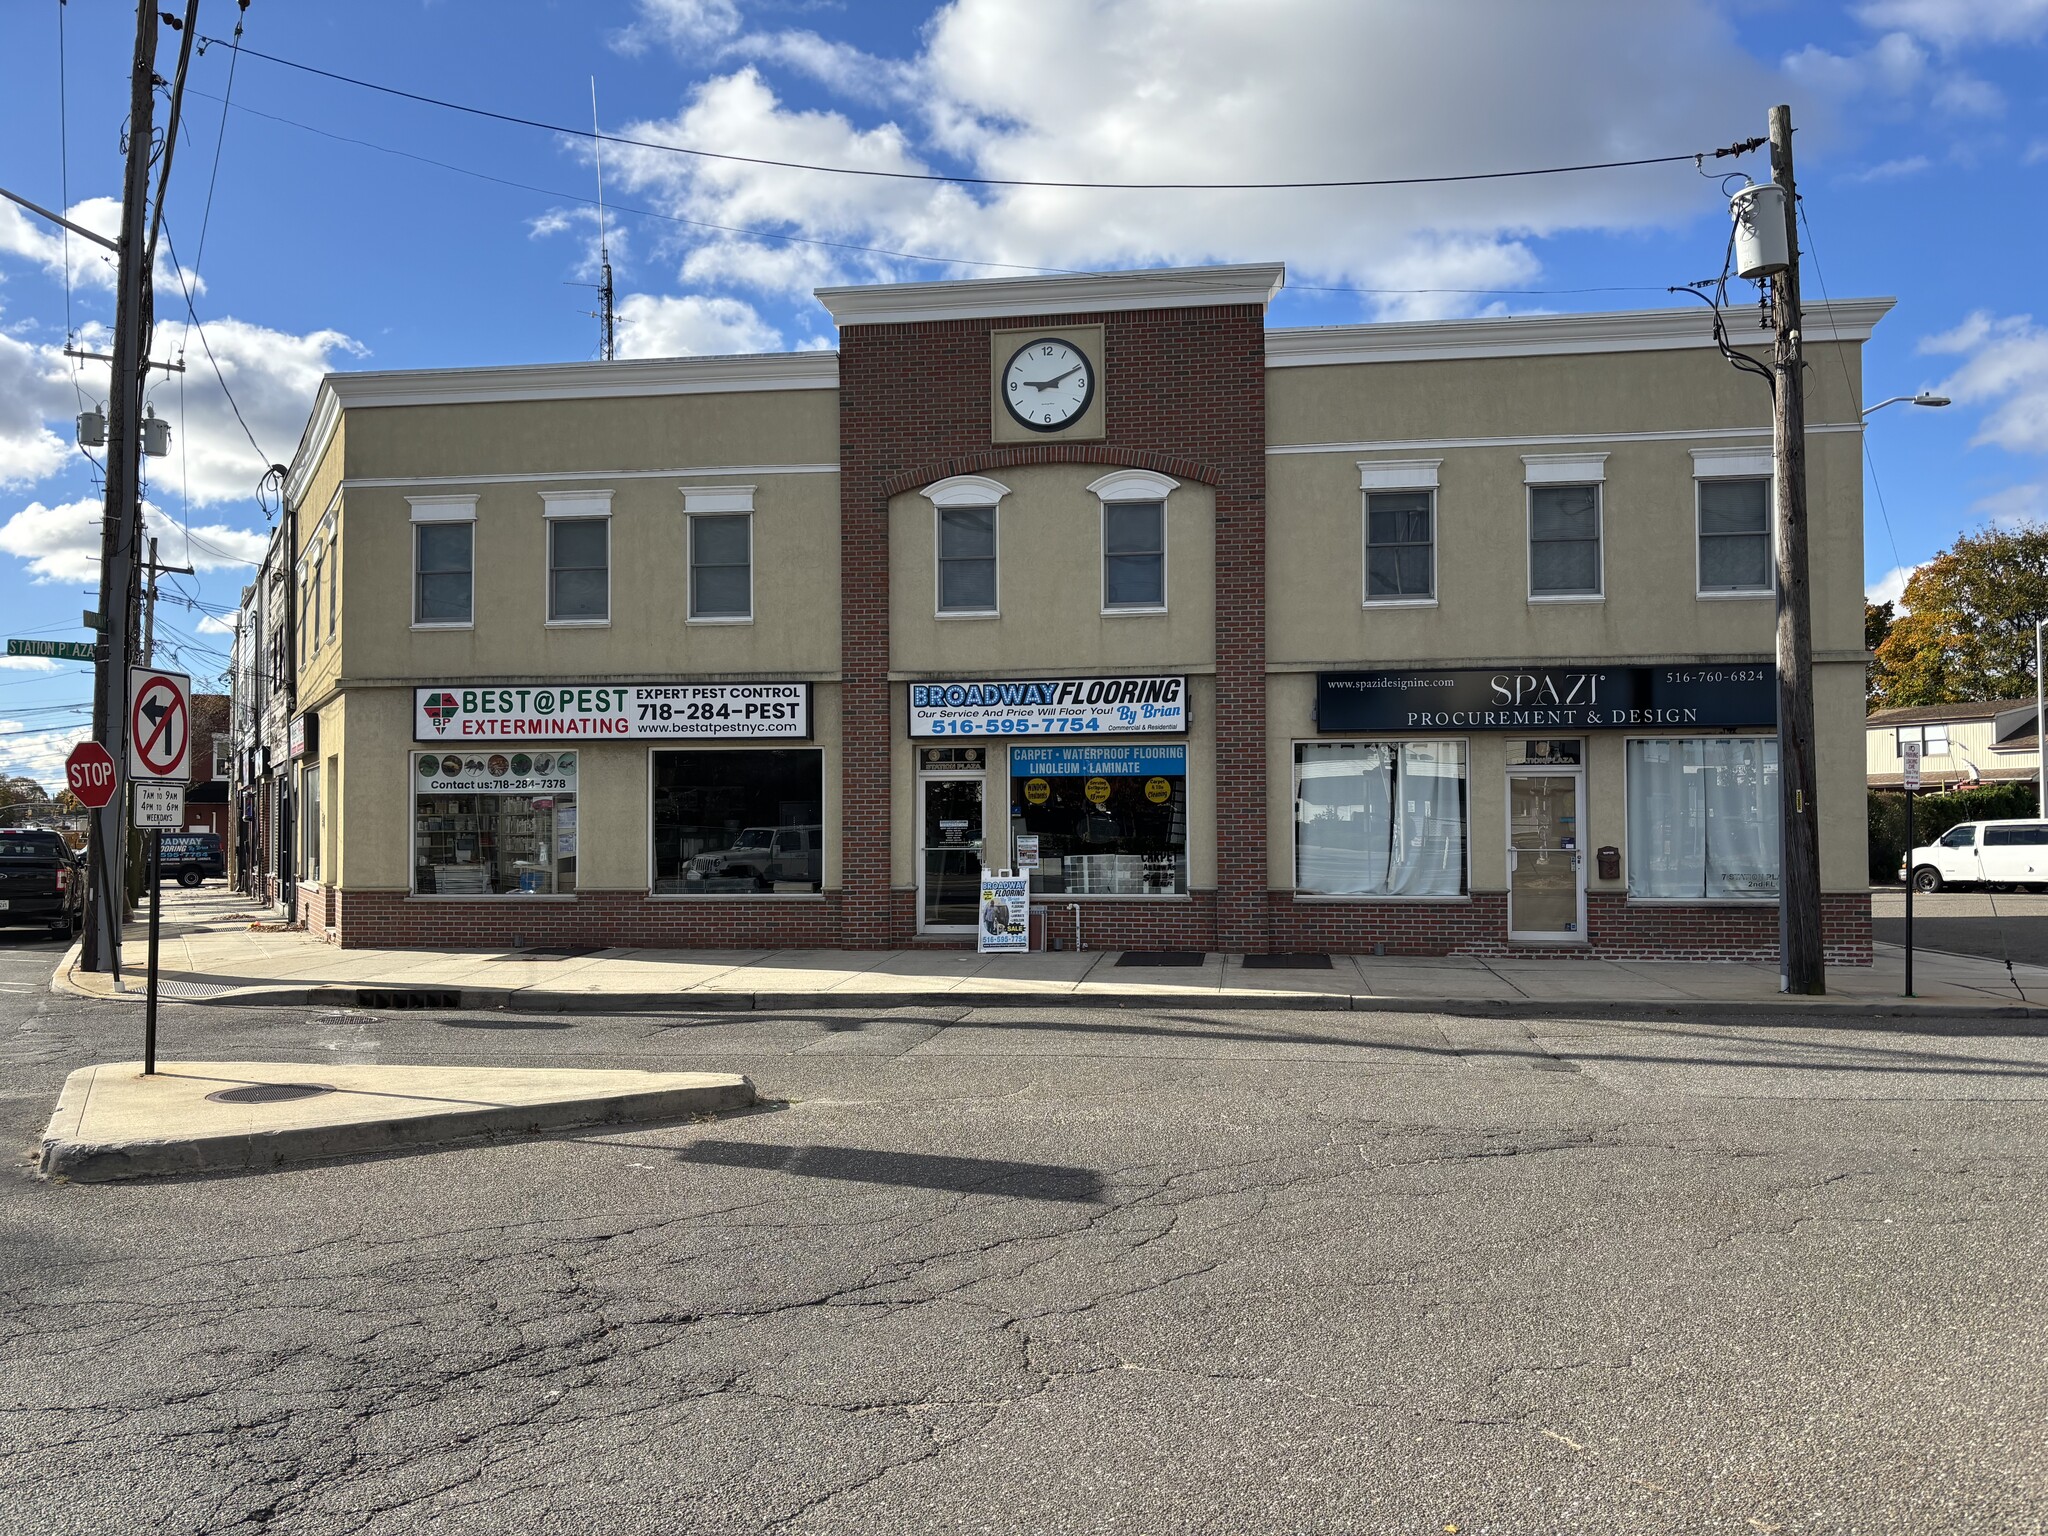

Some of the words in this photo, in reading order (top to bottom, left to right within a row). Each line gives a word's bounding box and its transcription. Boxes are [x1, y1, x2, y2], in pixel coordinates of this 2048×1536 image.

[1042, 346, 1053, 356] 12
[1010, 382, 1018, 392] 9
[1078, 379, 1085, 388] 3
[1044, 414, 1051, 423] 6
[10, 640, 55, 655] STATION
[1666, 671, 1763, 683] 516-760-6824
[1328, 678, 1454, 691] www.spazidesigninc.com
[636, 689, 689, 699] EXPERT
[692, 688, 726, 699] PEST
[730, 687, 800, 698] CONTROL
[913, 683, 1059, 707] BROADWAY
[1057, 679, 1181, 705] FLOORING
[462, 689, 629, 715] BEST@PEST
[637, 703, 800, 721] 718-284-PEST
[917, 710, 937, 718] Our
[940, 709, 979, 718] Service
[982, 709, 1003, 717] And
[1038, 708, 1056, 716] Will
[1090, 707, 1113, 715] You!
[1116, 706, 1137, 725] By
[1141, 704, 1180, 719] Brian
[1408, 710, 1577, 726] PROCUREMENT
[1587, 711, 1603, 724] &
[1612, 709, 1697, 723] DESIGN
[432, 719, 451, 727] BP
[462, 718, 629, 735] EXTERMINATING
[638, 722, 797, 735] www.bestatpestnyc.com
[932, 718, 1099, 734] 516-595-7754
[1014, 749, 1053, 760] CARPET
[1063, 748, 1130, 760] WATERPROOF
[1134, 748, 1184, 759] FLOORING
[1030, 763, 1080, 774] LINOLEUM
[1089, 762, 1140, 773] LAMINATE
[70, 762, 112, 788] STOP
[431, 780, 475, 790] Contact
[143, 790, 154, 799] 7AM
[166, 791, 177, 800] 9AM
[141, 802, 153, 810] 4PM
[166, 802, 178, 811] 6PM
[146, 814, 172, 822] WEEKDAYS
[982, 881, 1026, 890] BROADWAY
